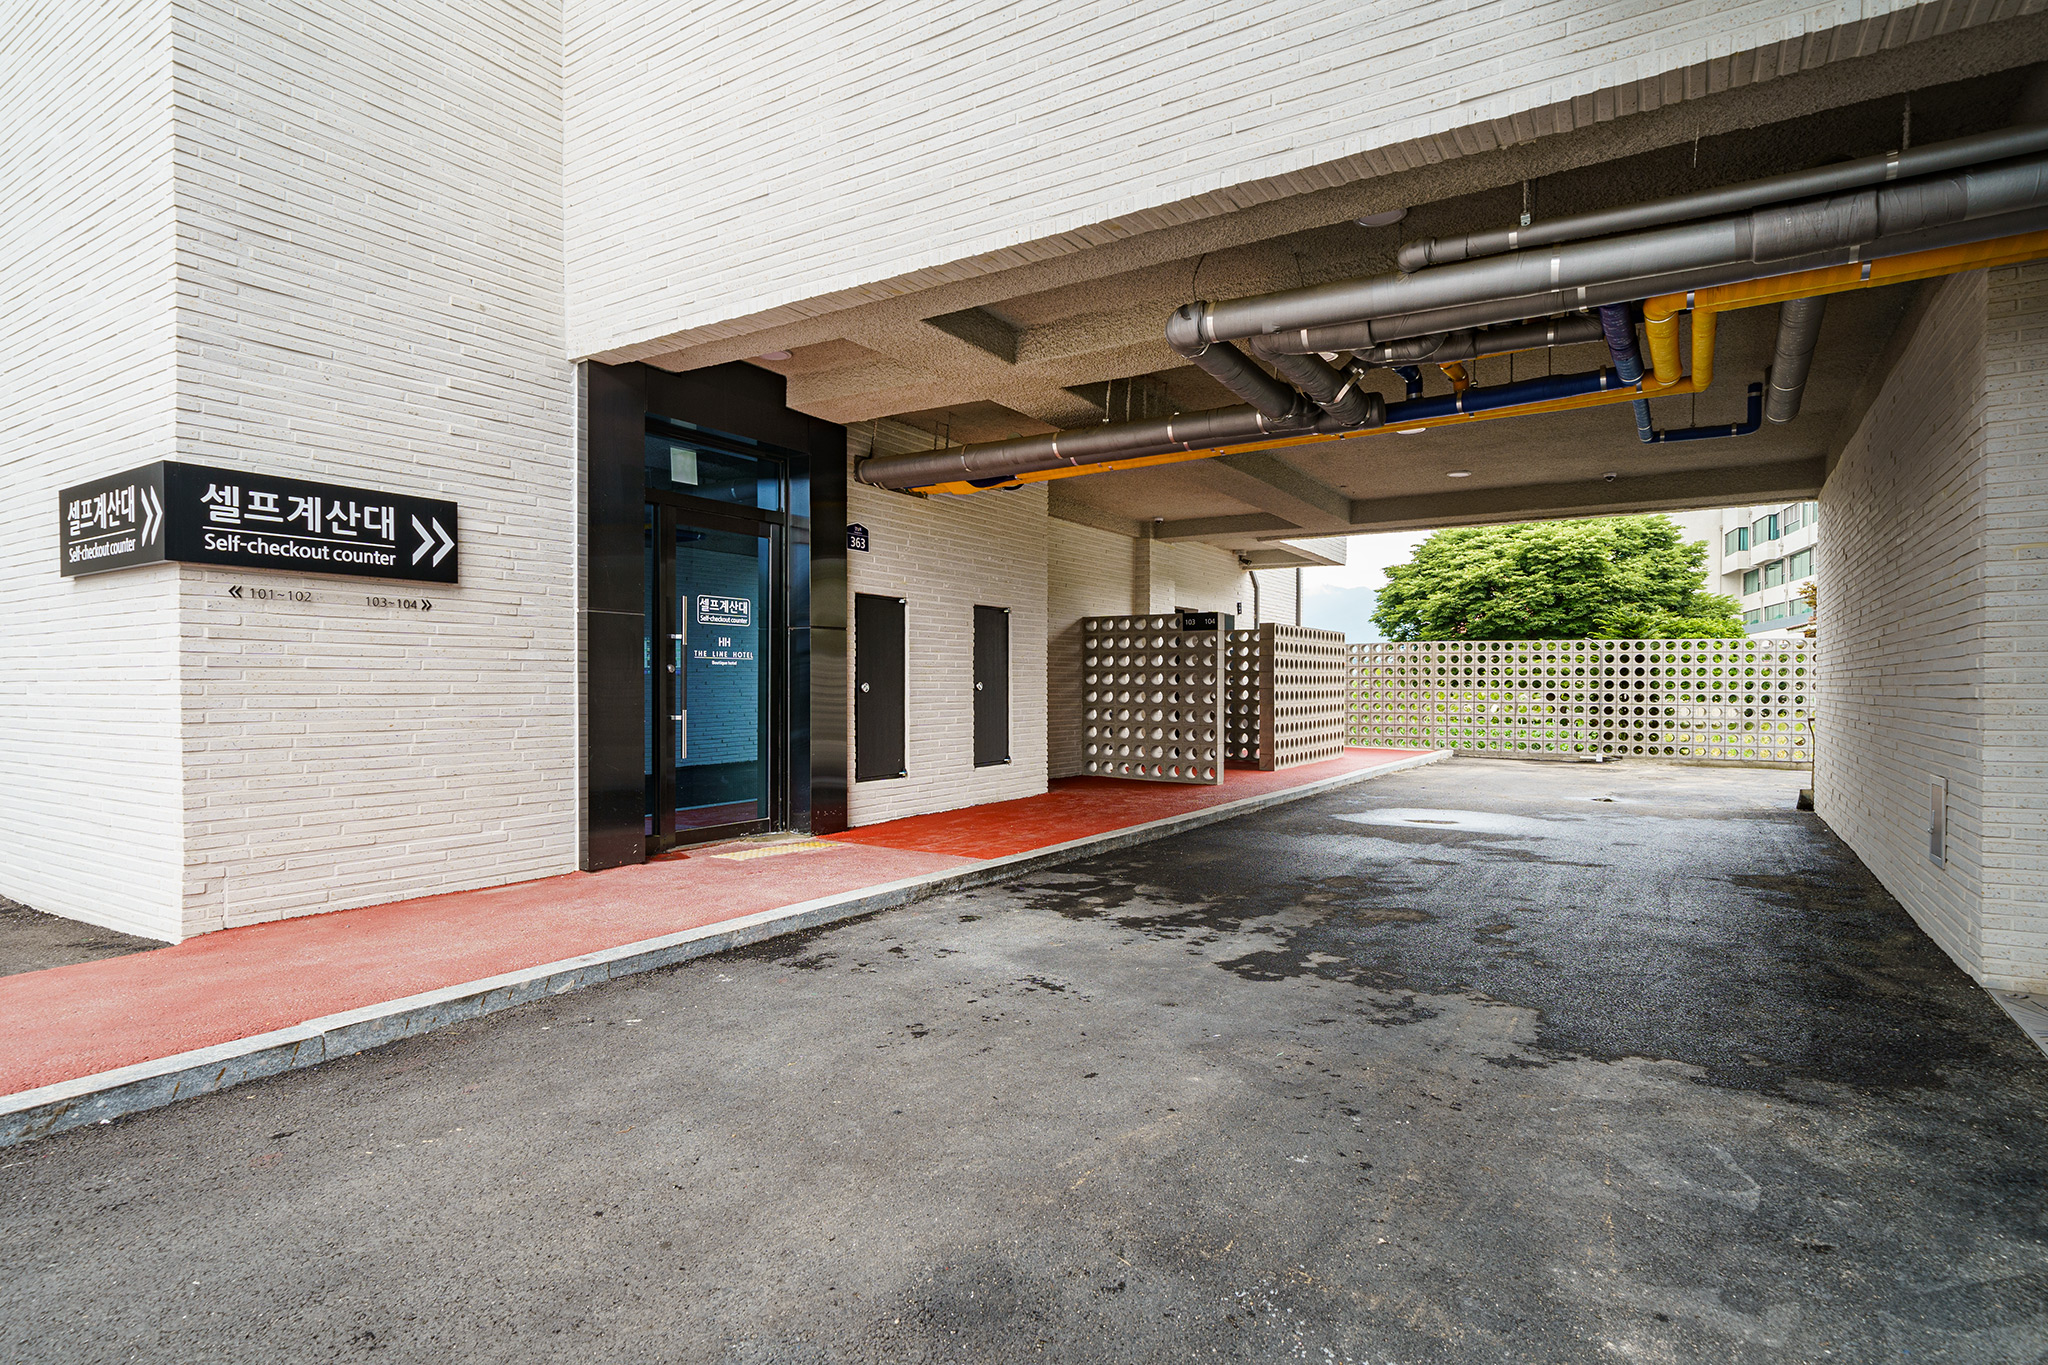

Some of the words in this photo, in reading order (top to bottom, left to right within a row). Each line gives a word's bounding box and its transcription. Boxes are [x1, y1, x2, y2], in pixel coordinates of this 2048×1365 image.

[67, 485, 135, 537] 셀프계산대
[200, 483, 396, 541] 셀프계산대
[69, 541, 110, 563] Self-checkout
[110, 537, 136, 555] counter
[204, 533, 330, 561] Self-checkout
[333, 549, 397, 566] counter
[850, 536, 866, 549] 363
[250, 588, 312, 602] 101~102
[366, 597, 417, 609] 103~104
[700, 598, 748, 614] 셀프계산대
[700, 615, 730, 623] Self-checkout
